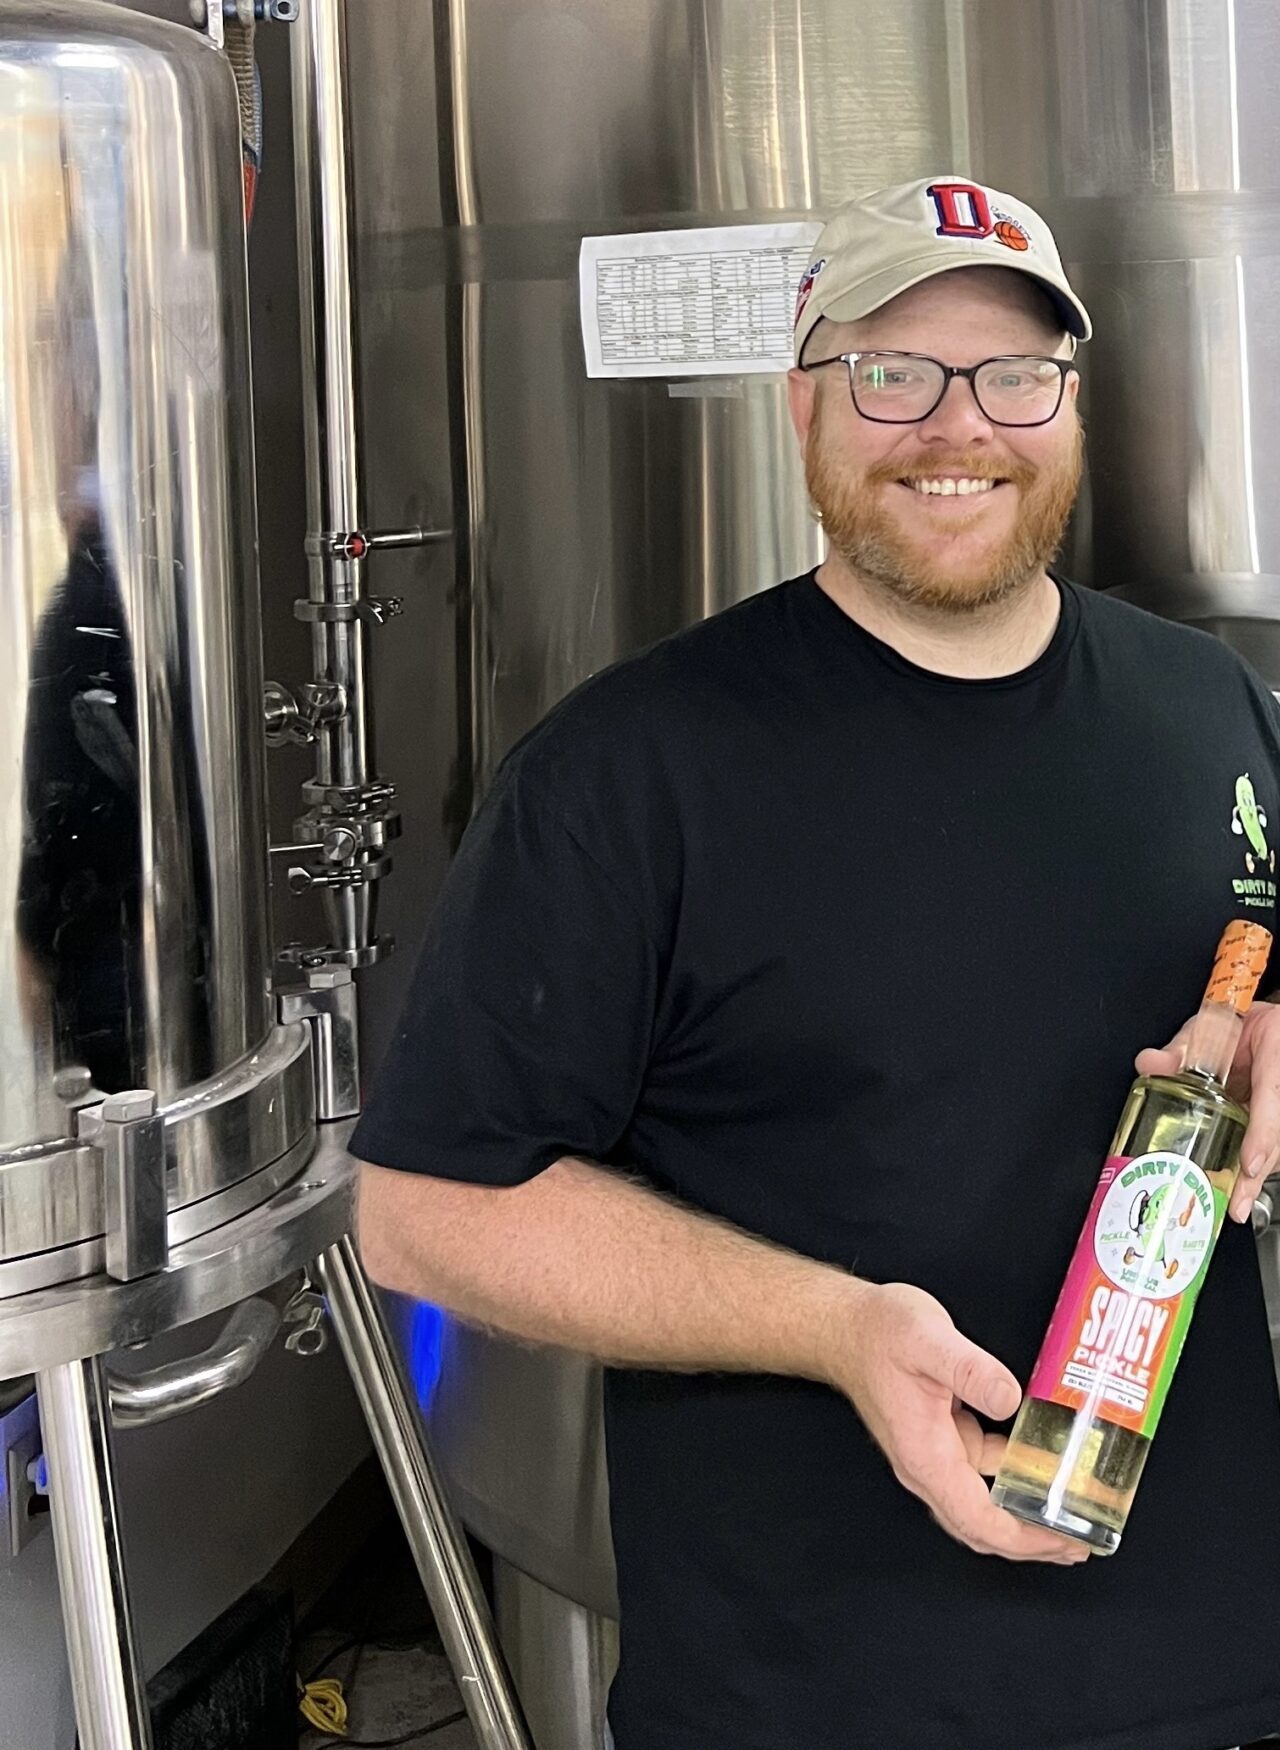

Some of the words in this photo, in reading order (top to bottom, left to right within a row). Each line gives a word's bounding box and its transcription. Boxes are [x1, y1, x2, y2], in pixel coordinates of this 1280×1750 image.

[926, 184, 994, 240] D
[1121, 1161, 1181, 1188] DIRTY
[1184, 1171, 1211, 1217] DILL
[1079, 1285, 1170, 1368] SPICY
[1073, 1345, 1151, 1386] PICKLE
